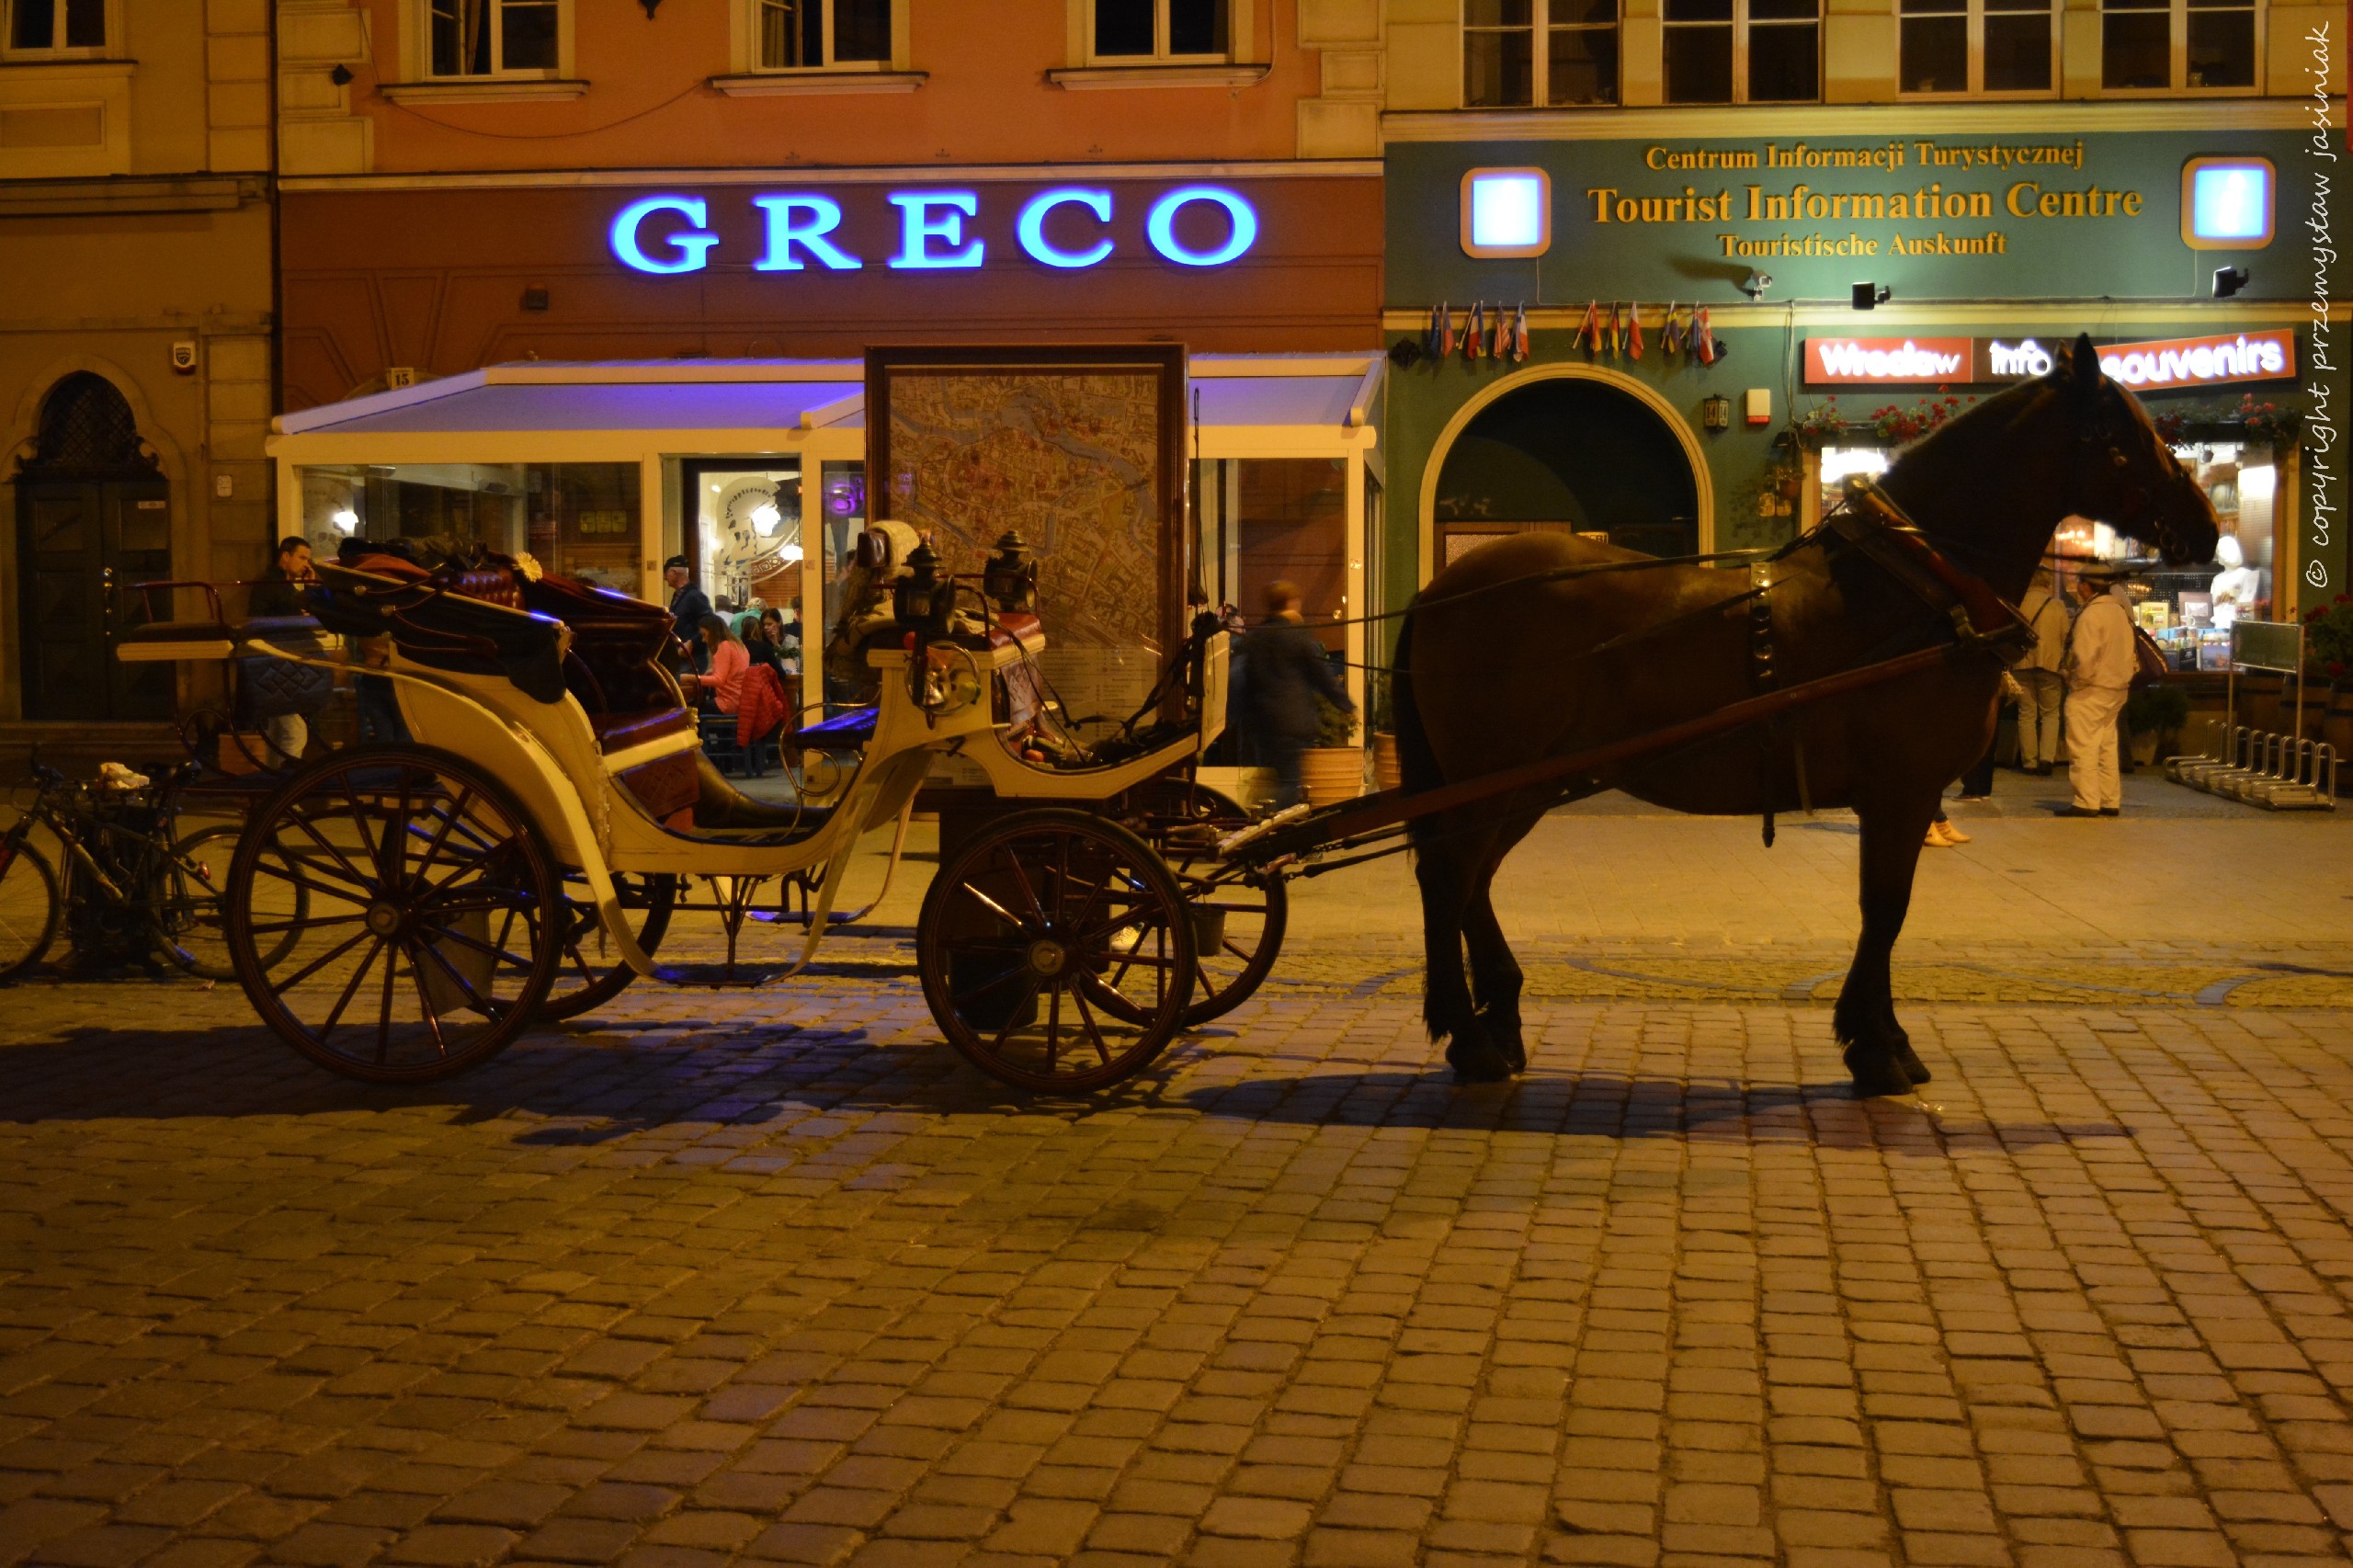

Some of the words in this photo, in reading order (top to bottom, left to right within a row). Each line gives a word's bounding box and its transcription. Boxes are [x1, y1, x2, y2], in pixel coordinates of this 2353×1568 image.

[1646, 146, 1758, 170] Centrum
[1766, 142, 1905, 173] Informacji
[1913, 141, 2085, 171] Turystycznej
[1586, 187, 1733, 224] Tourist
[1745, 183, 1993, 222] Information
[2006, 181, 2143, 219] Centre
[612, 187, 1257, 275] GRECO
[1718, 233, 1878, 258] Touristische
[1887, 232, 2008, 256] Auskunft
[2099, 335, 2284, 384] souvenirs
